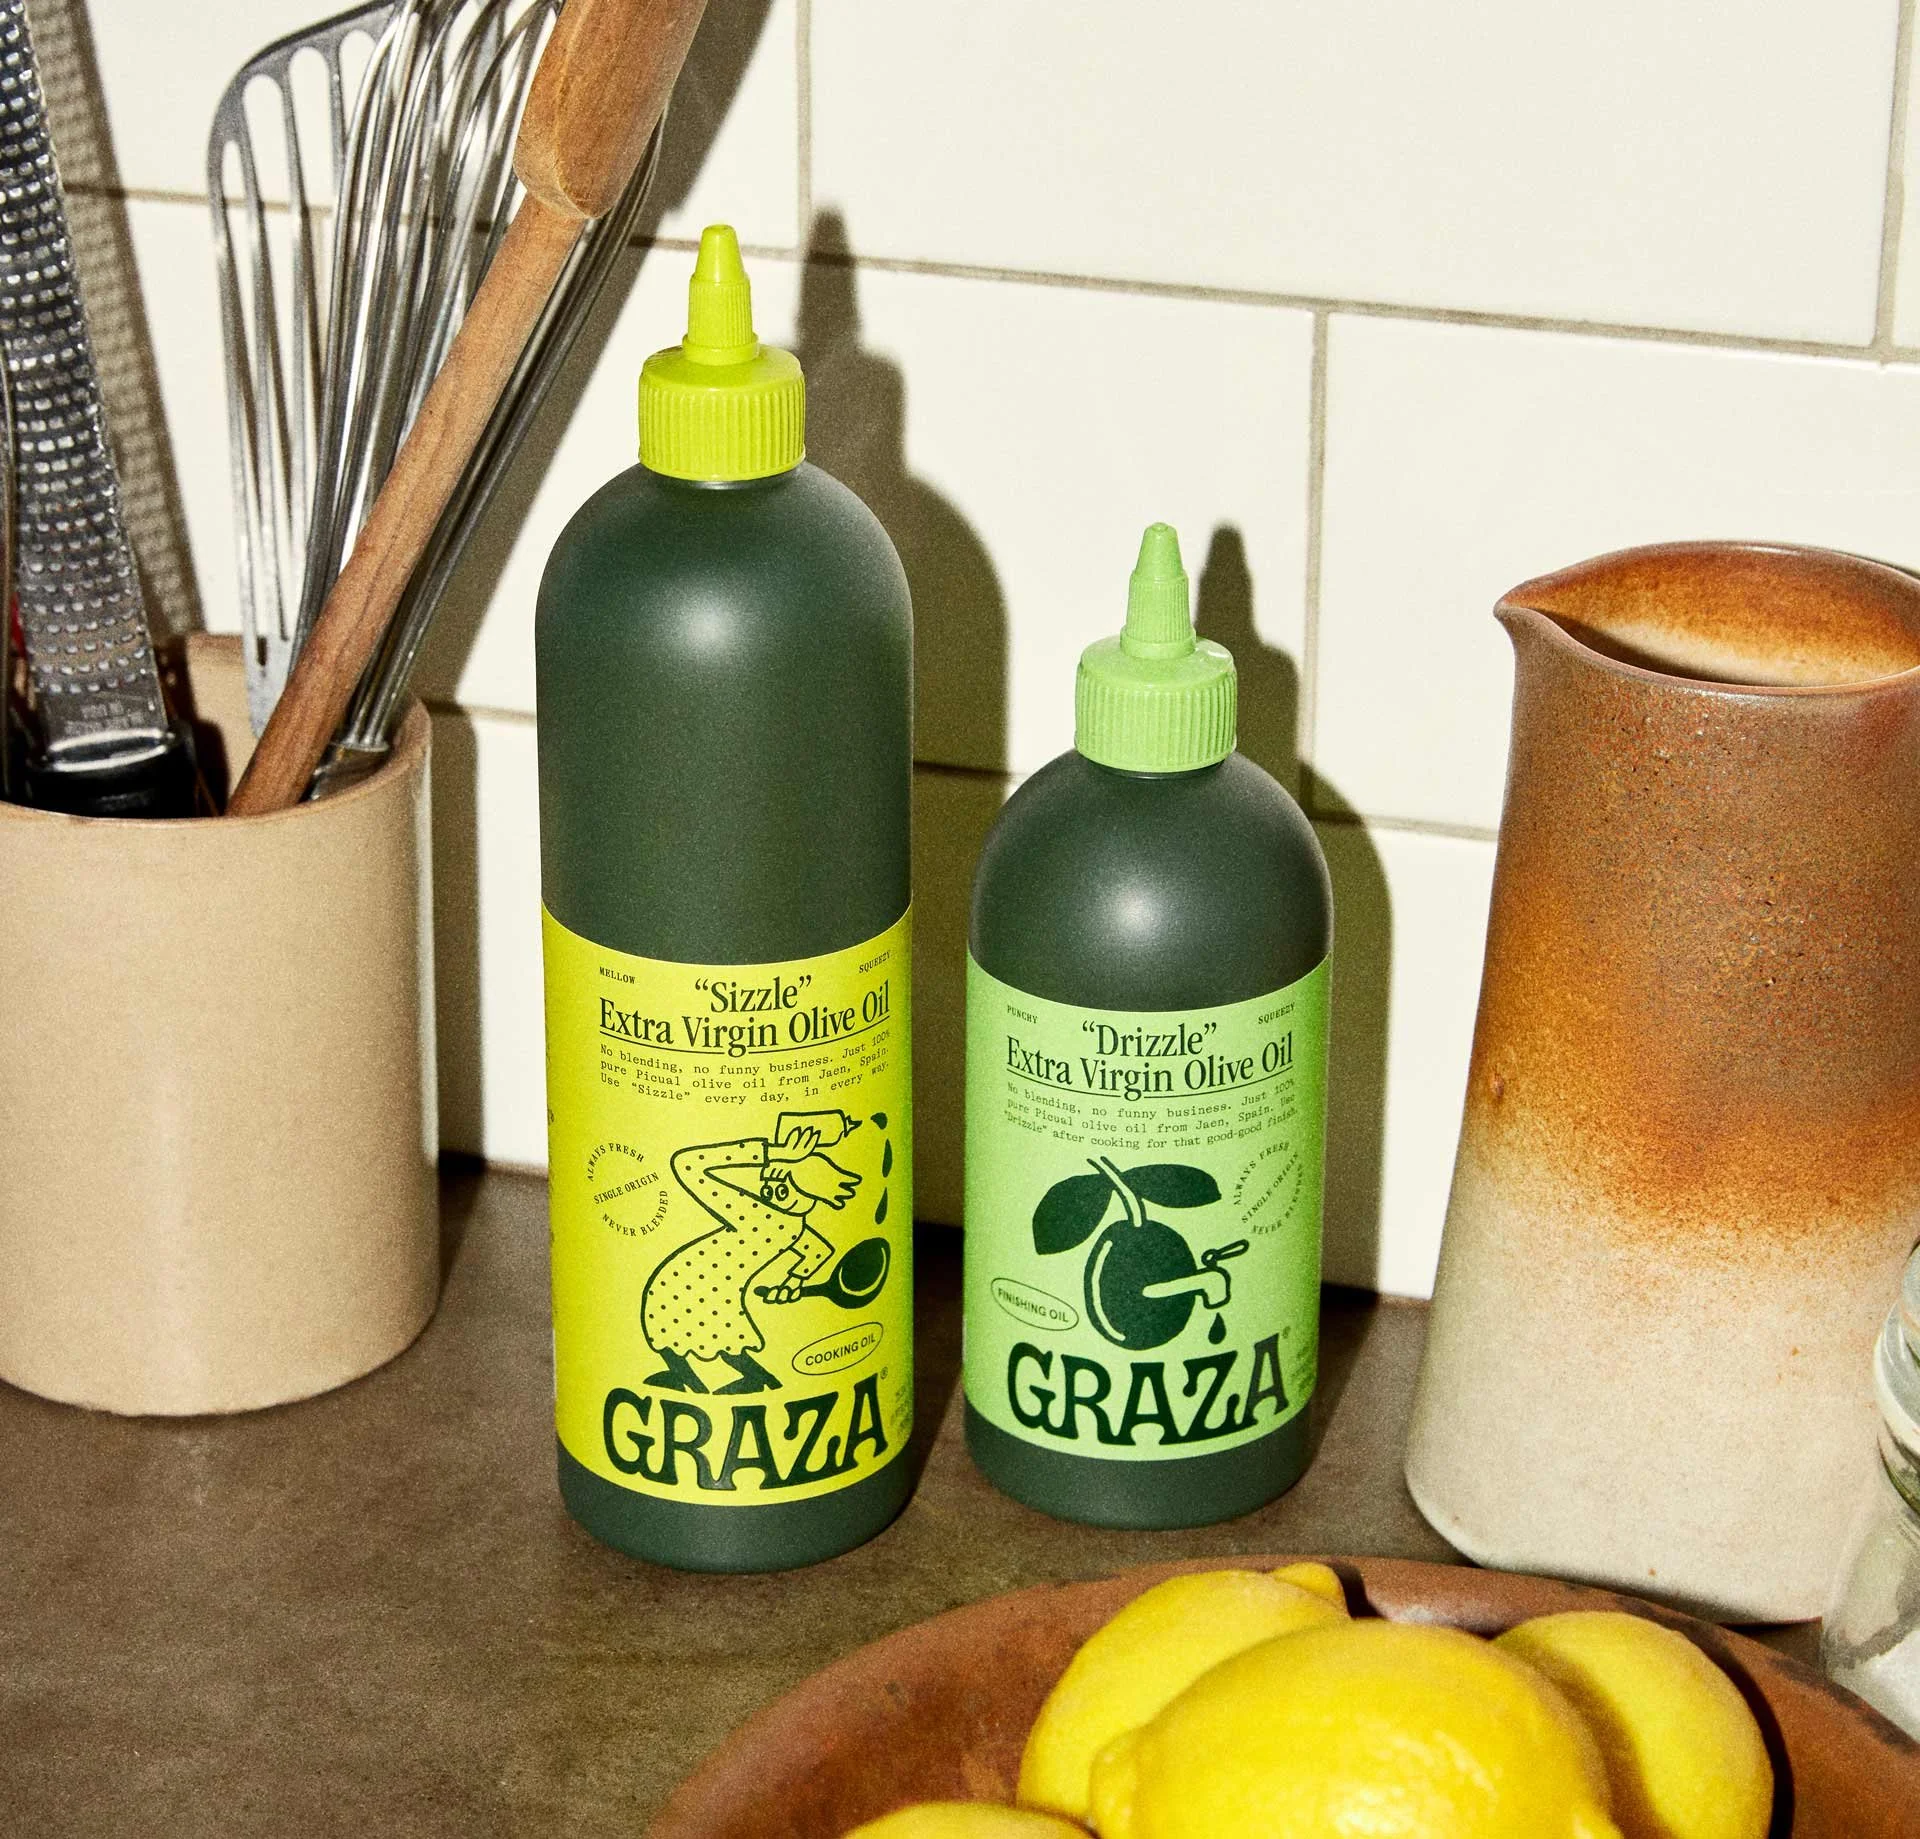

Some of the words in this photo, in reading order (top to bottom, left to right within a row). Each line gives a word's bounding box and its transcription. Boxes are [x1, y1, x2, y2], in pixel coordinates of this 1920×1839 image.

[600, 966, 636, 984] MELLOW
[859, 951, 891, 973] SQUEEZY
[695, 975, 812, 1013] “Sizzle”
[600, 997, 674, 1045] Extra
[682, 1016, 778, 1058] Virgin
[789, 1006, 855, 1043] Olive
[862, 979, 889, 1023] Oil
[1007, 1005, 1038, 1024] PUNCHY
[1258, 1002, 1295, 1024] SQUEEZY
[1082, 1020, 1217, 1058] “Drizzle”
[601, 1044, 613, 1057] No
[620, 1050, 683, 1074] blending,
[694, 1065, 709, 1074] no
[720, 1064, 760, 1076] funny
[770, 1056, 833, 1072] business.
[842, 1043, 865, 1059] Just
[601, 1060, 627, 1075] pure
[636, 1069, 681, 1086] Picual
[692, 1077, 731, 1089] olive
[743, 1078, 765, 1088] oil
[778, 1074, 809, 1086] from
[1007, 1035, 1072, 1085] Extra
[1080, 1057, 1174, 1101] Virgin
[1184, 1055, 1254, 1090] Olive
[1262, 1030, 1293, 1073] Oil
[601, 1073, 620, 1087] Use
[705, 1094, 747, 1105] every
[805, 1086, 819, 1096] in
[830, 1074, 863, 1091] every
[1092, 1107, 1107, 1116] no
[1118, 1108, 1157, 1120] funny
[1167, 1103, 1232, 1118] business.
[1241, 1092, 1266, 1106] Just
[1008, 1099, 1030, 1113] pure
[1035, 1108, 1073, 1126] Picual
[1082, 1120, 1117, 1132] olive
[1125, 1123, 1146, 1133] oil
[1157, 1123, 1187, 1133] from
[1053, 1130, 1085, 1144] after
[1091, 1136, 1140, 1150] cooking
[1147, 1138, 1167, 1148] for
[1174, 1136, 1201, 1147] that
[1207, 1123, 1262, 1145] good-good
[587, 1144, 606, 1182] ALWAYS
[608, 1142, 645, 1163] FRESH
[594, 1186, 624, 1205] SINGLE
[624, 1172, 660, 1193] ORIGIN
[1233, 1161, 1256, 1206] ALWAYS
[602, 1213, 636, 1237] NEVER
[641, 1190, 668, 1235] BLENDED
[1242, 1188, 1272, 1223] SINGLE
[998, 1288, 1046, 1316] FINISHING
[1049, 1309, 1069, 1323] OIL
[805, 1341, 859, 1366] COOKING
[861, 1333, 876, 1348] OIL
[1007, 1333, 1289, 1446] GRAZA
[603, 1373, 888, 1491] GRAZA
